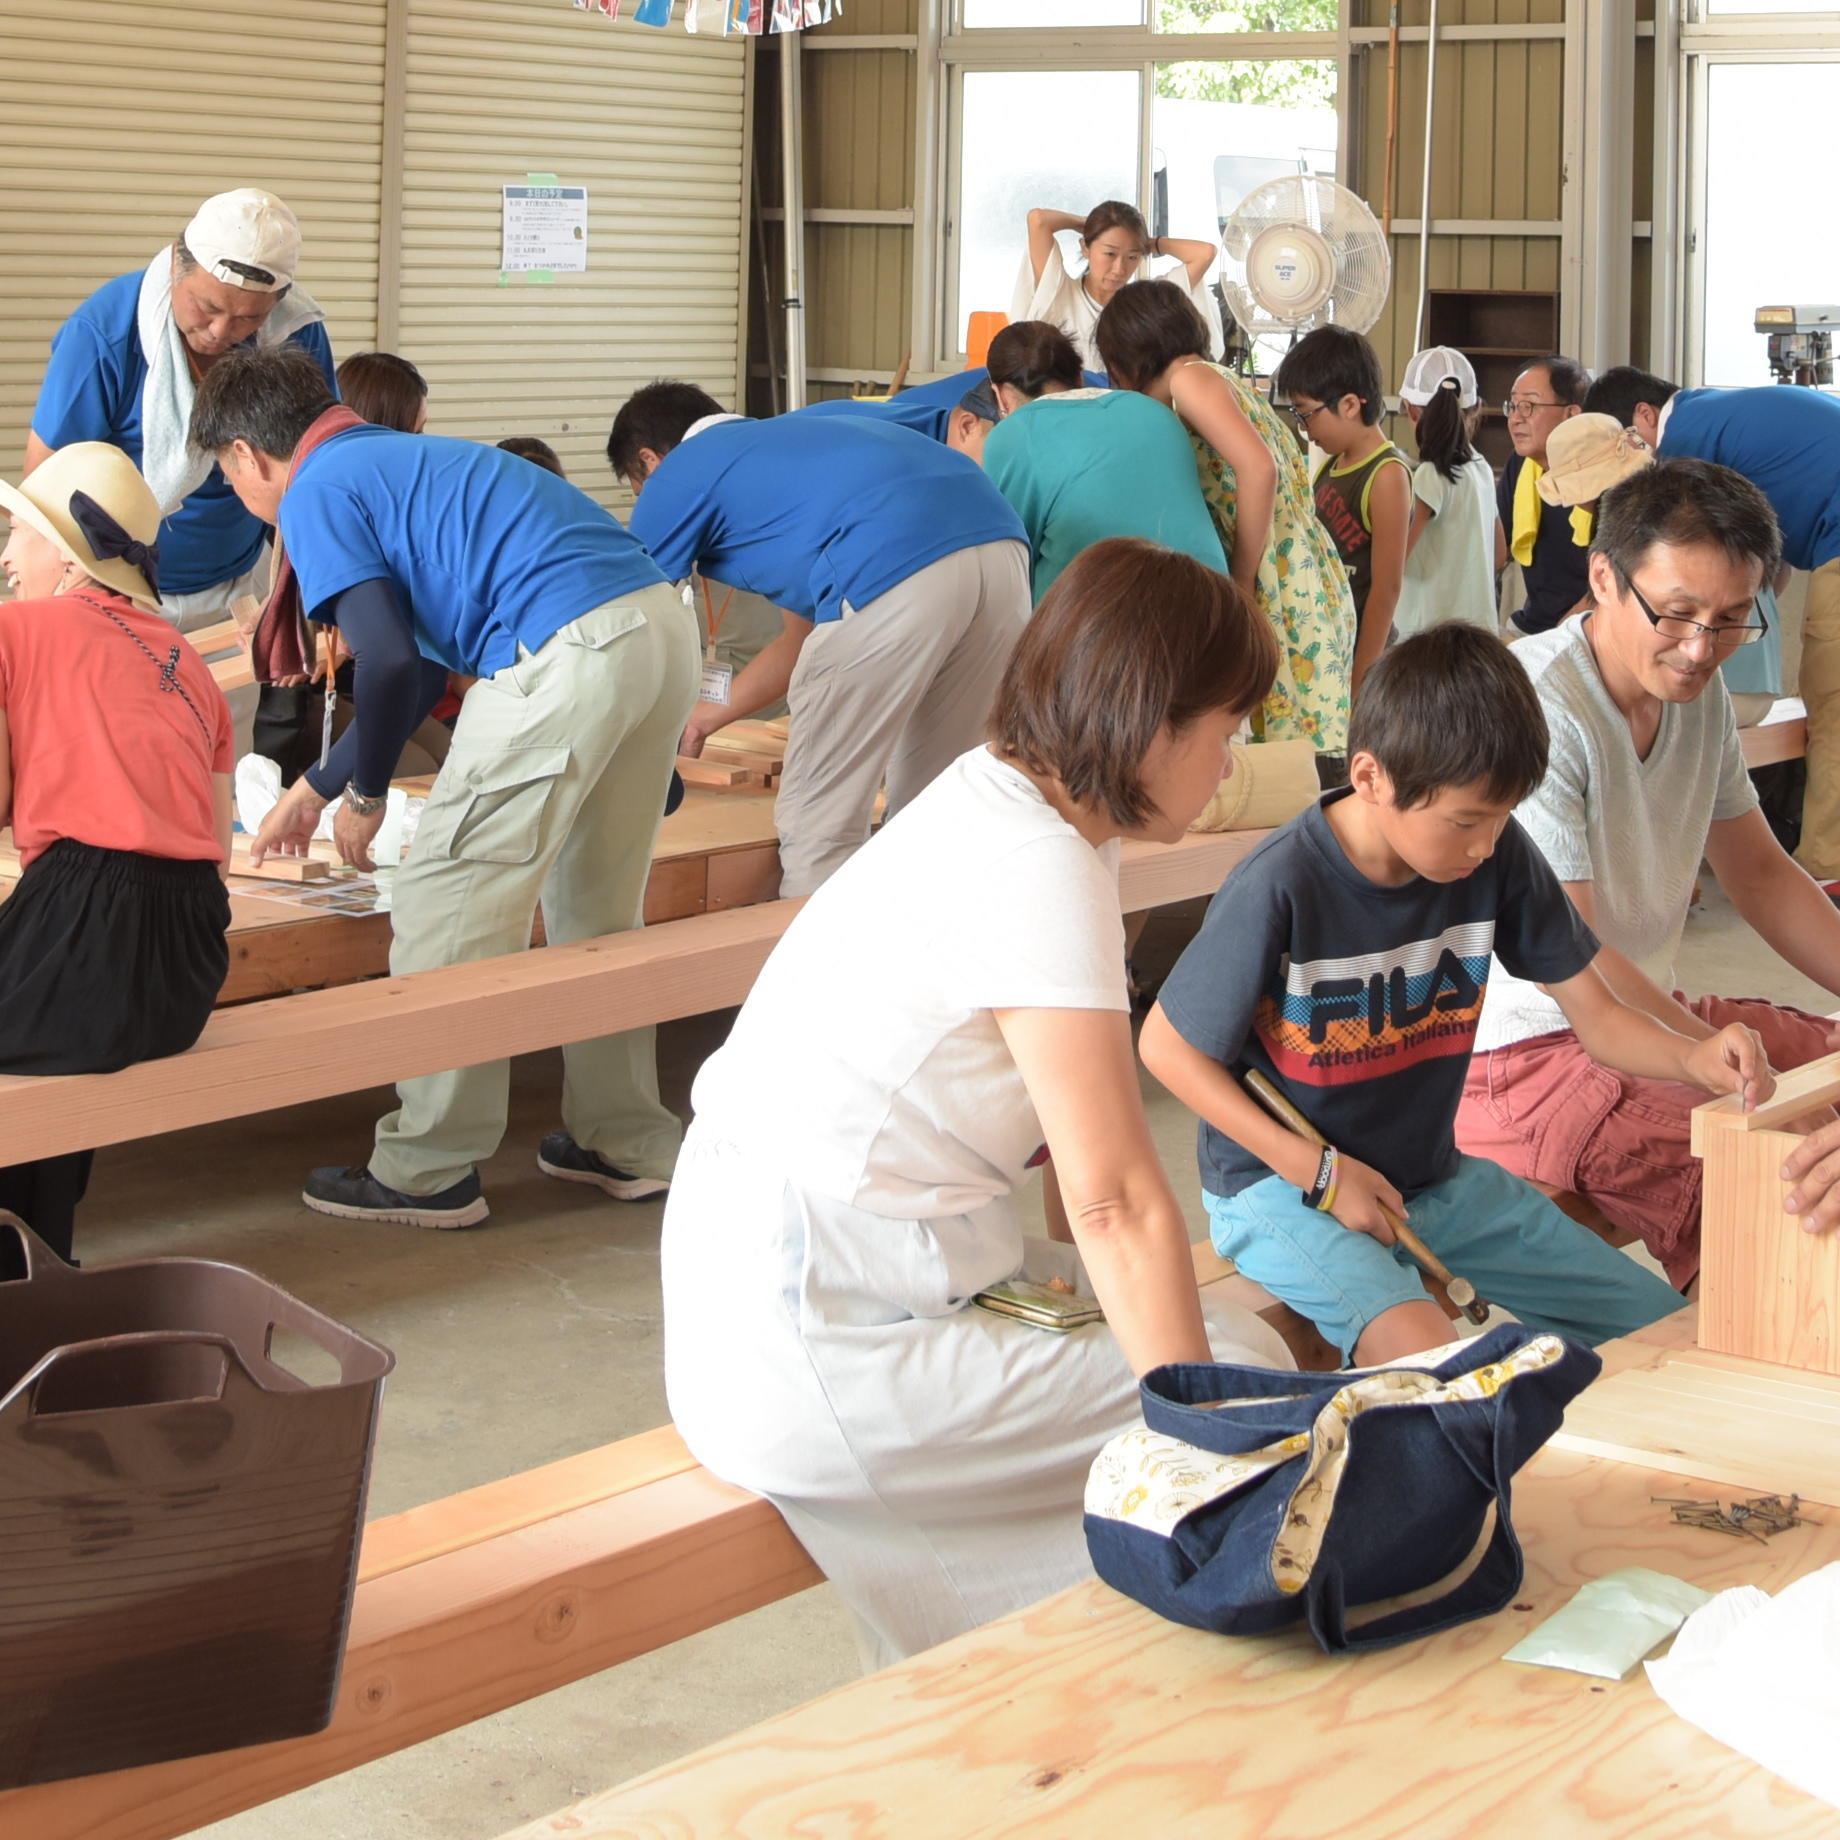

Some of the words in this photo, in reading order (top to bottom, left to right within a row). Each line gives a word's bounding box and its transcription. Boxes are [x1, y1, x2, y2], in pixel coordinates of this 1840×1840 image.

[1309, 947, 1480, 1045] FILA
[1308, 1042, 1397, 1067] Atletica
[1403, 1019, 1479, 1050] Italiana
